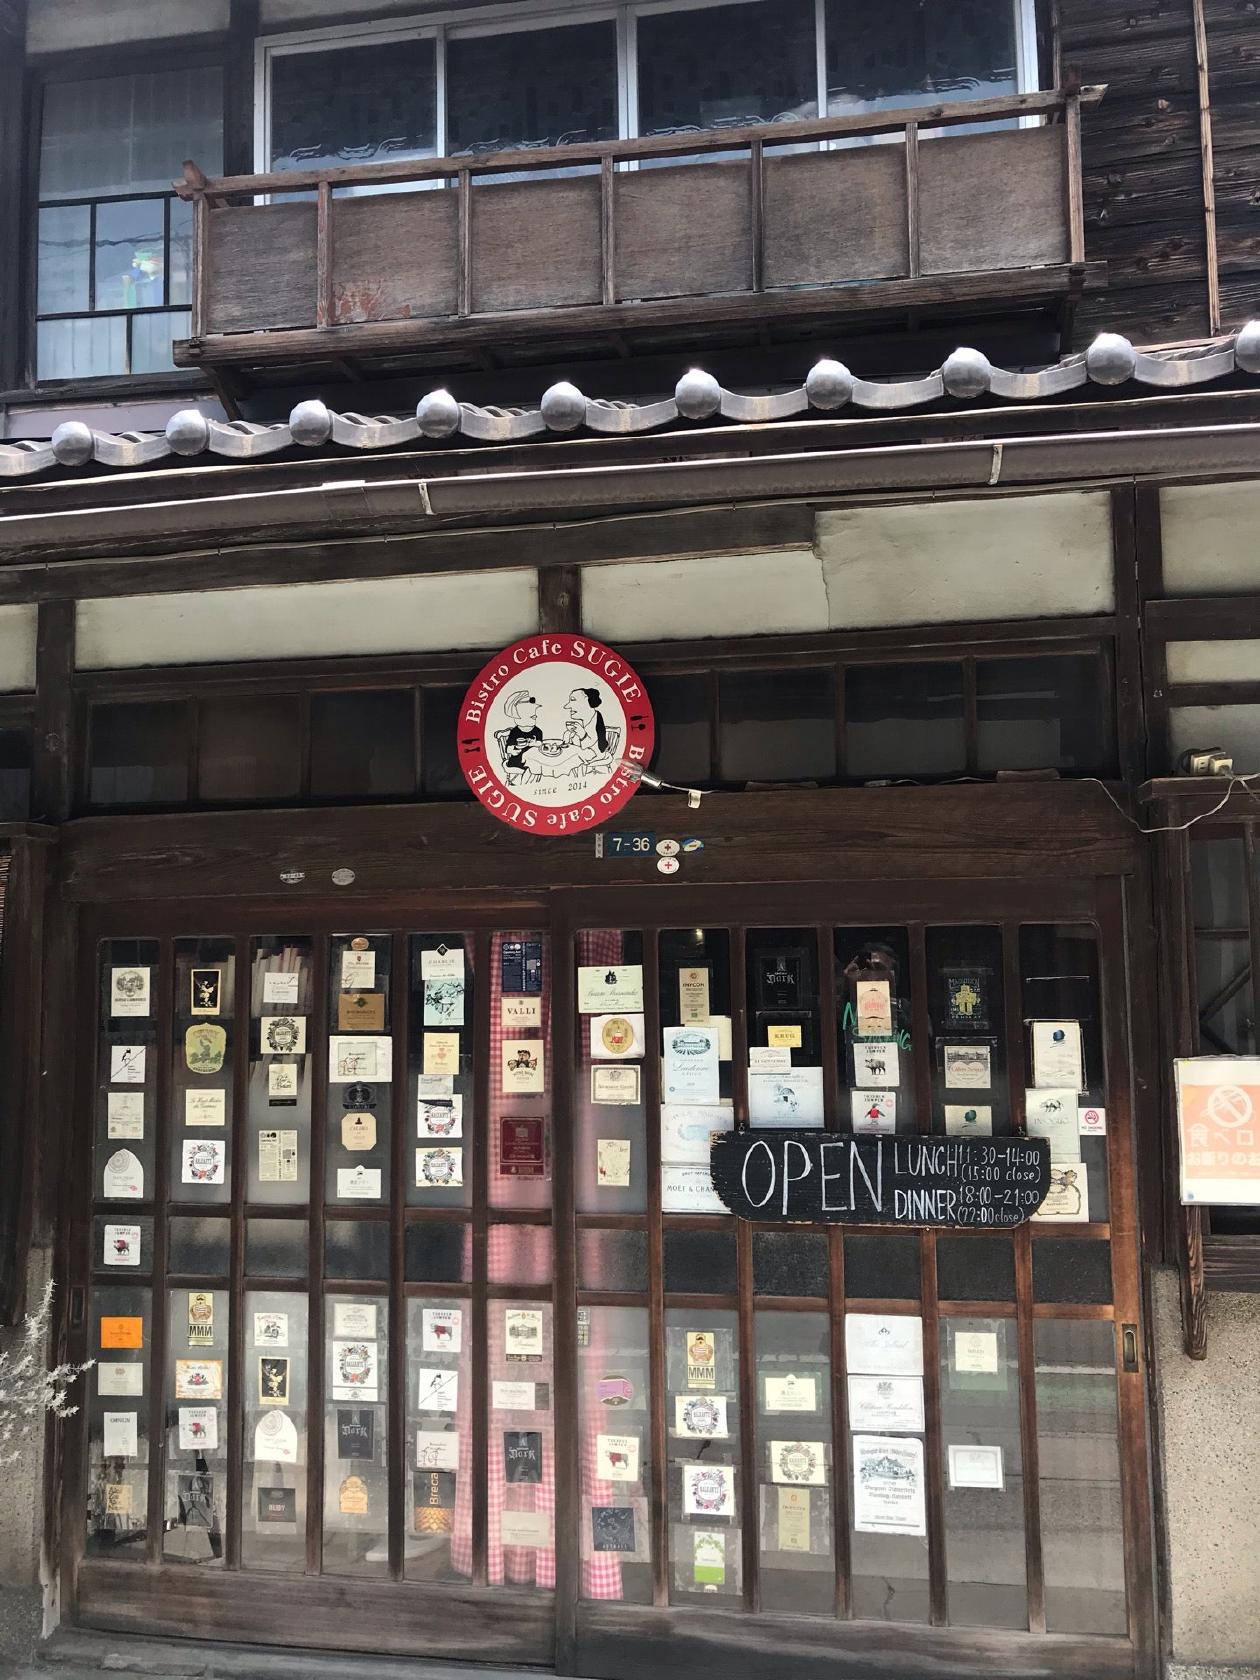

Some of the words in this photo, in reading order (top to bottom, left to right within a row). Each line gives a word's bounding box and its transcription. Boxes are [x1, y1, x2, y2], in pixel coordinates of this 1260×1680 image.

[466, 664, 509, 724] Bistro
[512, 639, 562, 664] Cafe
[570, 641, 642, 703] SUGIE
[600, 744, 645, 804] Bstro
[468, 765, 538, 827] SUGIE
[546, 805, 596, 829] Cafe
[612, 837, 651, 852] 7-36
[507, 1007, 536, 1016] VALLI
[894, 1142, 958, 1177] LUNCH
[741, 1140, 883, 1216] OPEN
[1005, 1166, 1041, 1183] close)
[894, 1188, 957, 1221] DINNER
[189, 1325, 212, 1337] MMM
[688, 1366, 714, 1379] MMM
